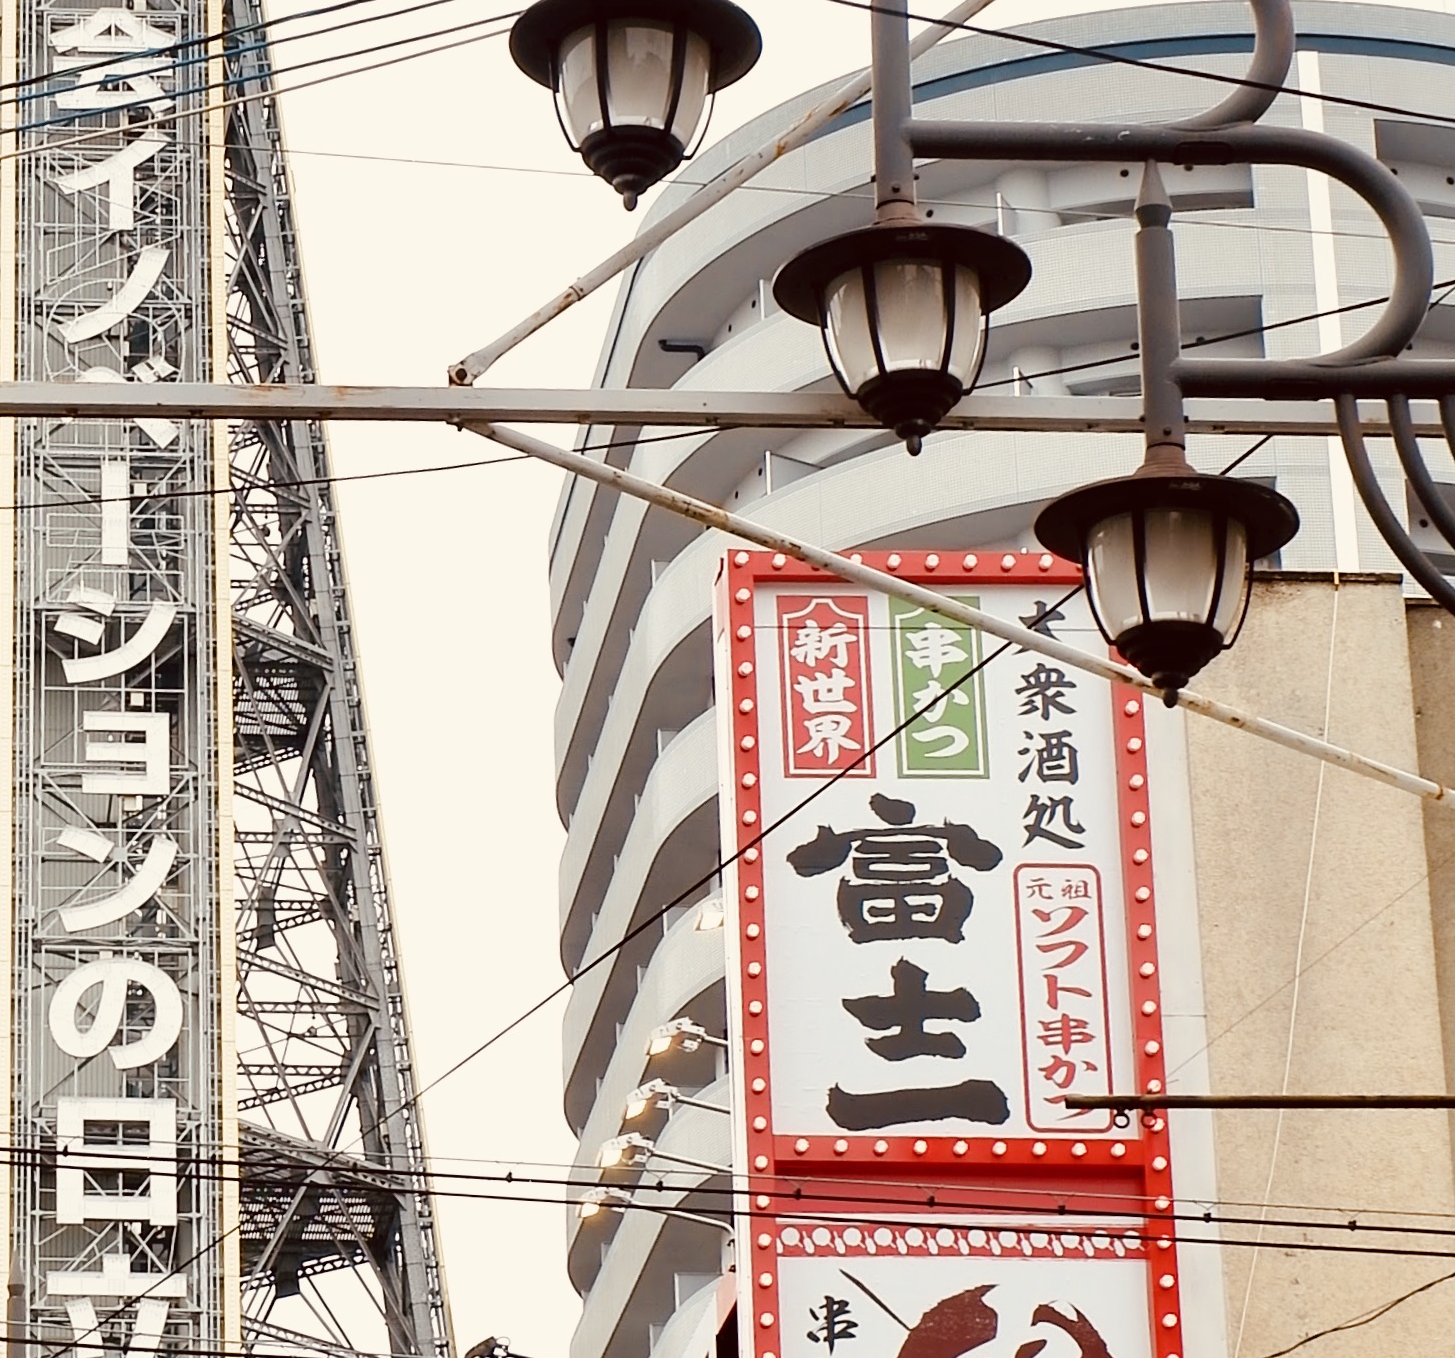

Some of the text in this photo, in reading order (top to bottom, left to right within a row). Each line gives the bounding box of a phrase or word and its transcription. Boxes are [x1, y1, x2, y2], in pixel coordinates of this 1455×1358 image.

[791, 619, 861, 765] 新世界
[905, 623, 972, 758] 串かつ
[1011, 600, 1086, 850] 大衆酒処
[1026, 878, 1092, 900] 元祖
[1032, 906, 1098, 1121] ソフト串かつ
